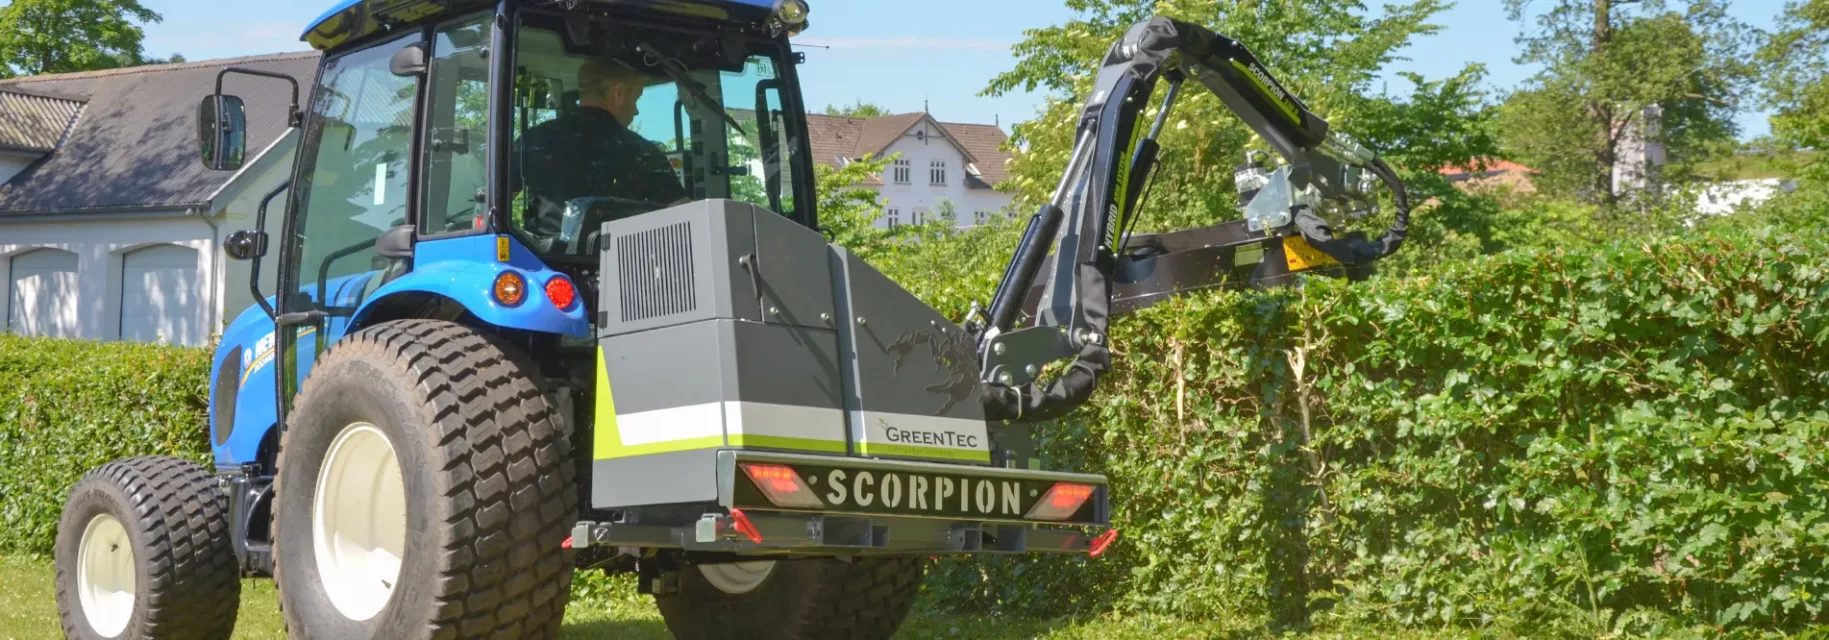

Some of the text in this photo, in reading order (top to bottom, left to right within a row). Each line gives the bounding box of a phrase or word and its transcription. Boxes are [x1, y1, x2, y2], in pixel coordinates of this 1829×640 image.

[1249, 62, 1285, 100] SCORPION
[1104, 203, 1118, 249] HYBRID
[827, 469, 1020, 515] SCORPION
